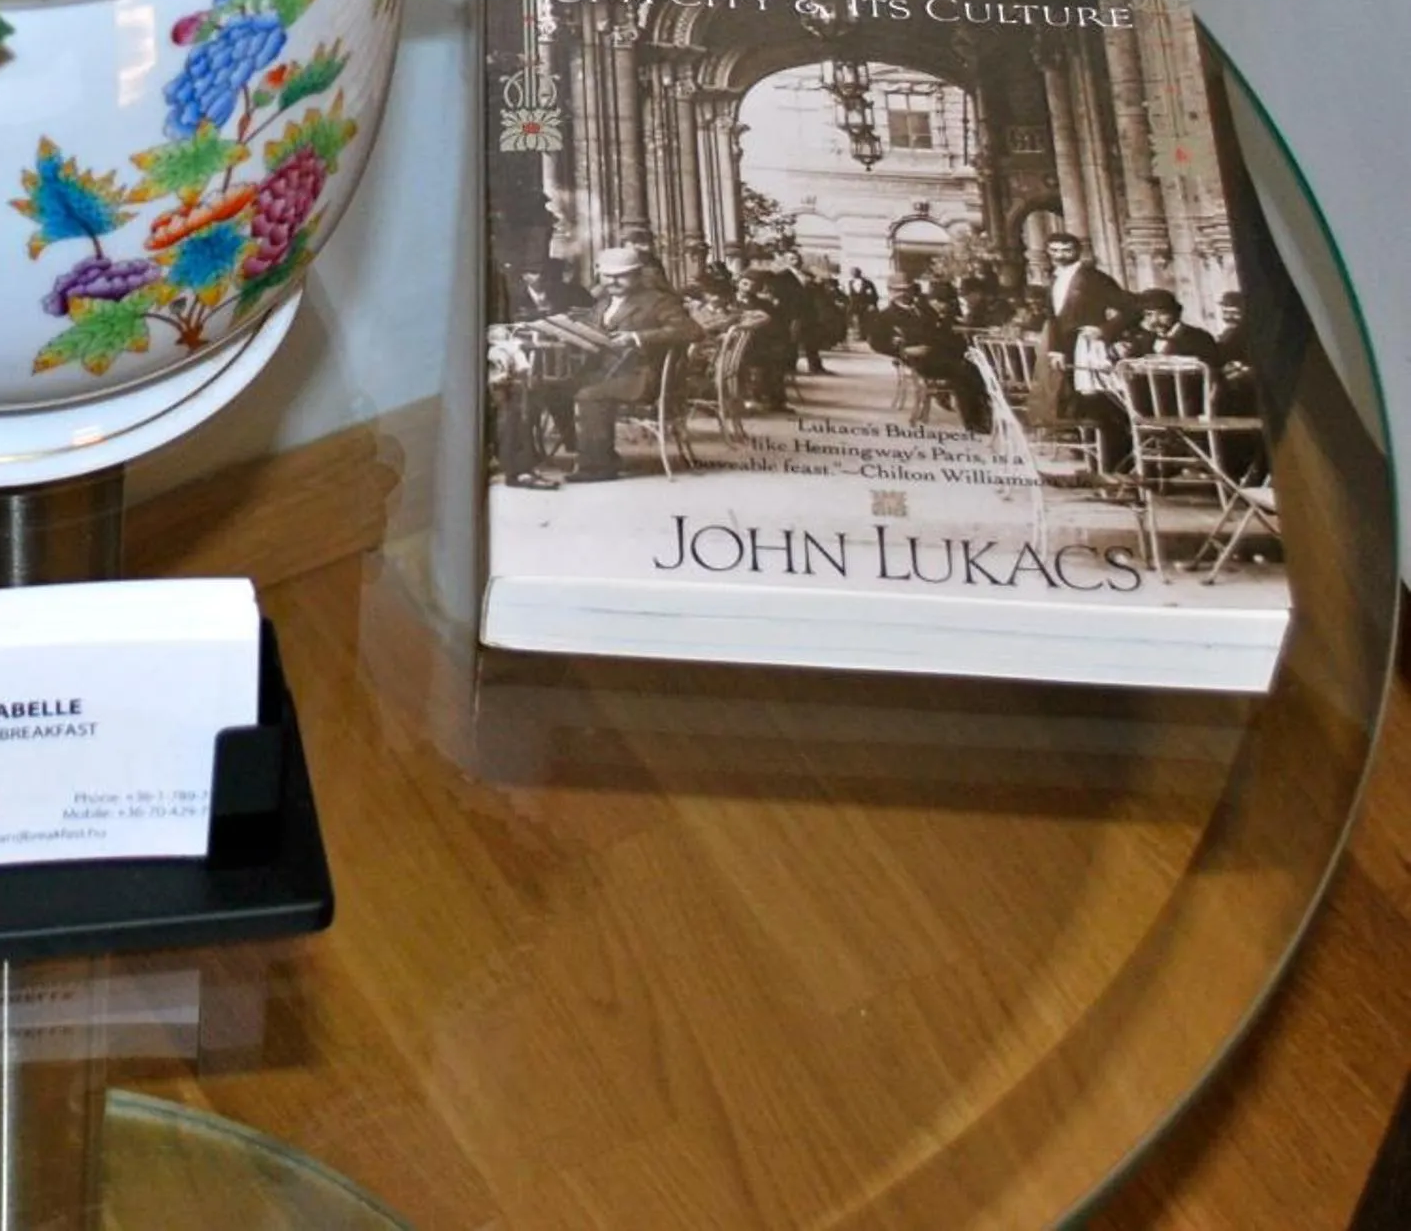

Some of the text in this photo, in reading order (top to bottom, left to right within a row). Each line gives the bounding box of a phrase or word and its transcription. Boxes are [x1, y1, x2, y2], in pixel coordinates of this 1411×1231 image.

[751, 436, 788, 453] like
[794, 438, 925, 462] Hemingway's
[1012, 454, 1024, 466] a
[653, 515, 1142, 592] JOHN LUKACS
[0, 722, 99, 742] BREAKFAST
